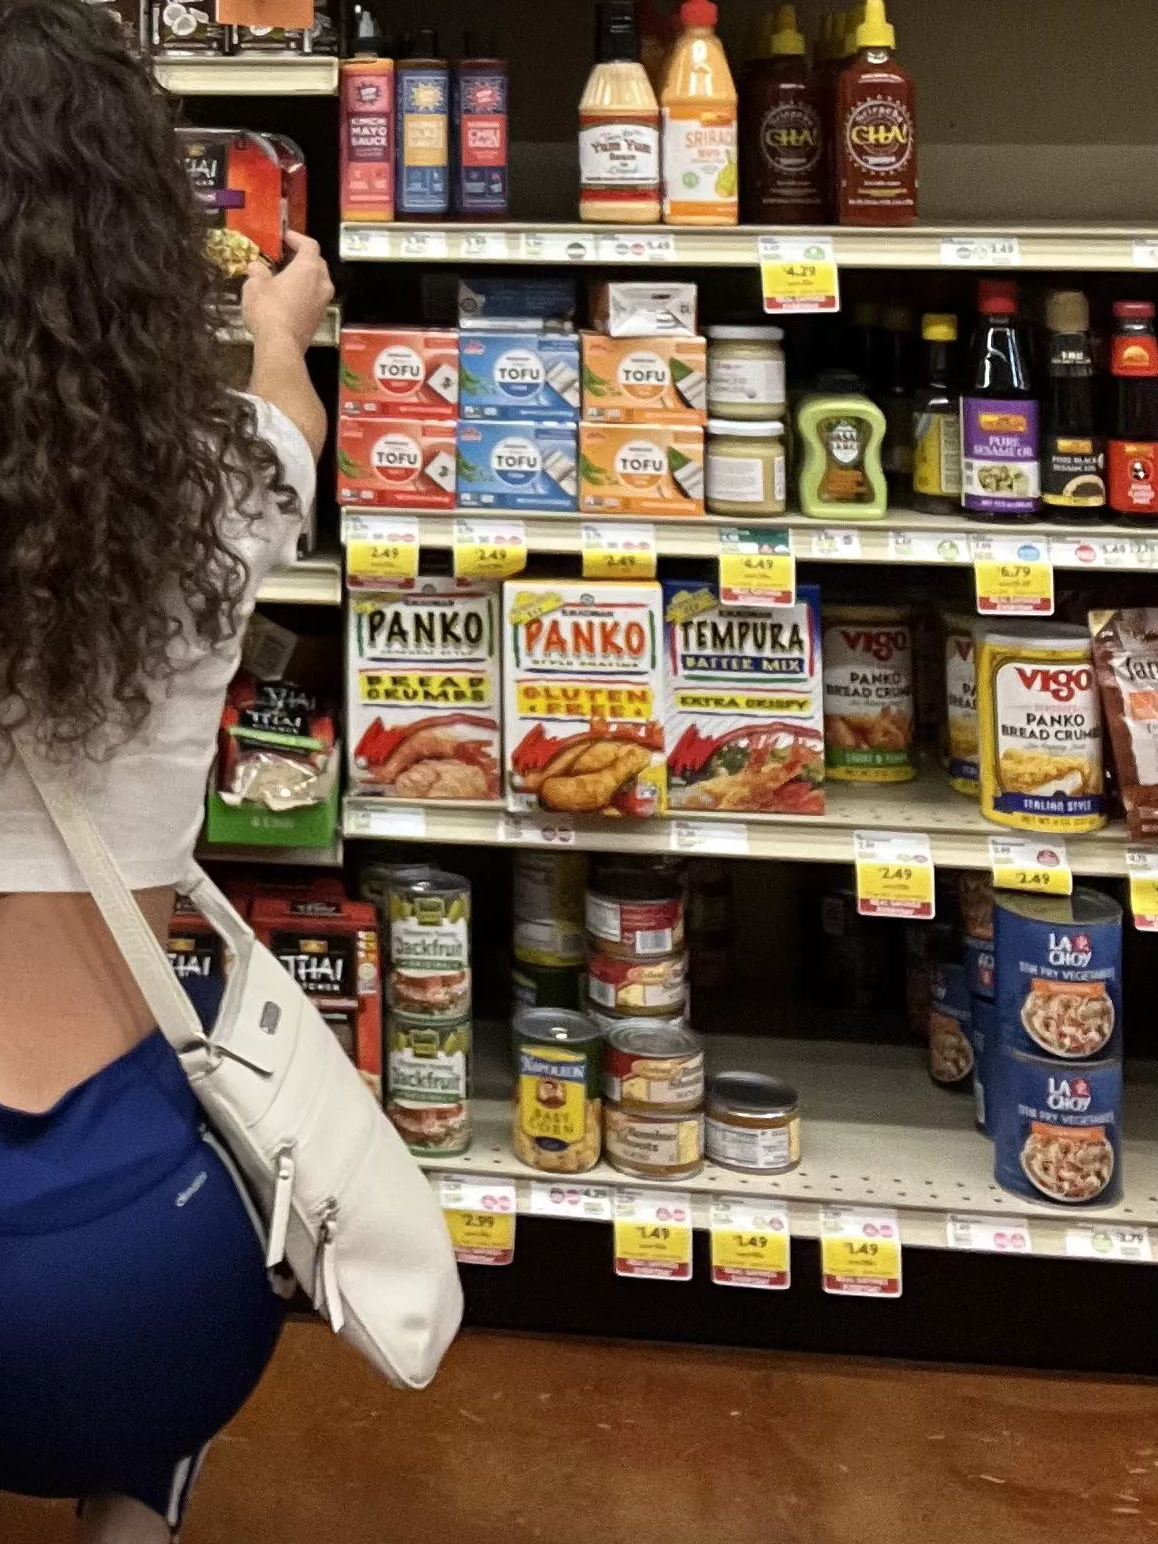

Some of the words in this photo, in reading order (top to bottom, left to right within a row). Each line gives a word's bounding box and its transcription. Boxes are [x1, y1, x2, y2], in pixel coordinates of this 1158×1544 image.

[351, 127, 387, 136] MAYO
[591, 141, 621, 153] Yum
[625, 140, 651, 154] Yum
[379, 364, 420, 377] TOFU
[499, 367, 540, 380] TOFU
[623, 369, 665, 382] TOFU
[989, 437, 1020, 446] PURE
[376, 452, 417, 465] TOFU
[495, 455, 537, 468] TOFU
[621, 459, 664, 472] TOFU
[368, 610, 483, 644] PANKO
[523, 619, 646, 656] PANKO
[680, 621, 804, 652] TEMPURA
[762, 660, 800, 671] MIX
[367, 676, 484, 687] BREAD
[850, 672, 902, 684] PANKO
[366, 688, 485, 701] CRUMBS
[523, 687, 648, 703] GLUTEN
[681, 696, 739, 708] EXTRA
[746, 699, 808, 709] CRISPY
[546, 704, 627, 716] FREE
[1026, 712, 1085, 727] PANKO
[1002, 725, 1051, 739] BREAD
[1054, 728, 1101, 741] CRUMB
[395, 939, 463, 957] Jackfruit
[1049, 933, 1072, 950] LA
[1049, 951, 1091, 968] CHOY
[1048, 1078, 1070, 1097] LA
